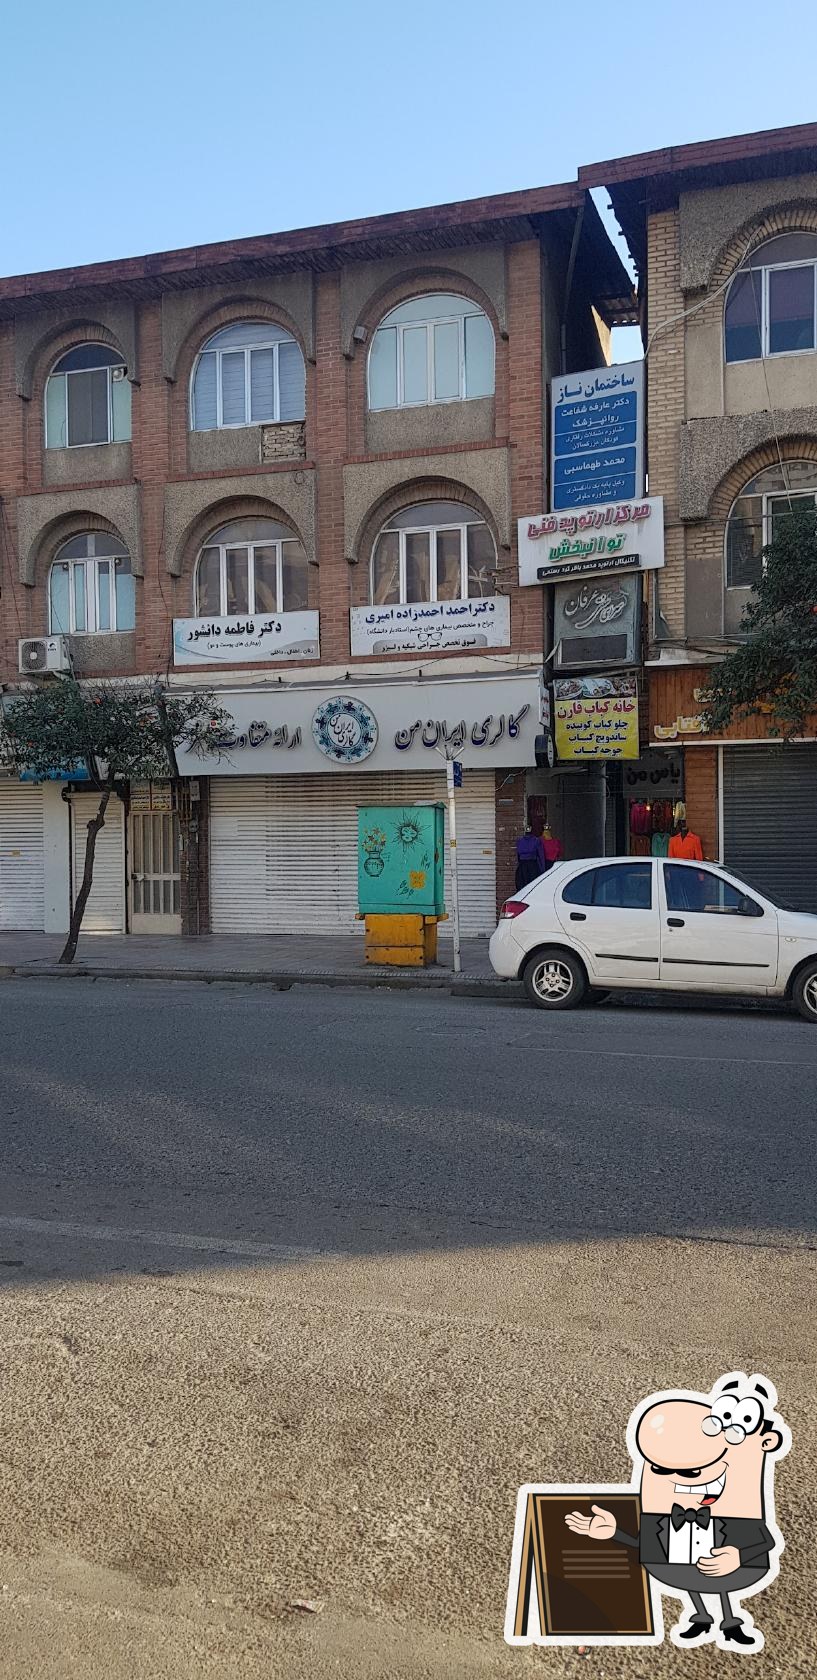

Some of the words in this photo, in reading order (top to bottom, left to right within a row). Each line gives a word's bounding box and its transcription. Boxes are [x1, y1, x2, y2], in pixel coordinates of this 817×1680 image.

[556, 381, 583, 404] ناز
[584, 373, 635, 398] ساختمان
[561, 403, 587, 417] شفاعت
[588, 400, 611, 412] عارفه
[612, 397, 630, 409] دکتر
[572, 414, 620, 428] روانپزشک
[563, 460, 601, 475] طهماسبی
[602, 457, 626, 467] محمد
[613, 503, 652, 524] مرکز
[527, 516, 558, 540] فنی
[614, 556, 636, 566] تکنیکال
[542, 568, 560, 577] رستمی
[564, 585, 600, 617] عرفان
[446, 602, 472, 616] احمد
[472, 601, 496, 617] دکتر
[365, 609, 394, 625] امیری
[187, 623, 222, 642] دانشور
[225, 620, 255, 635] فاطمه
[258, 619, 282, 638] دکتر
[417, 642, 441, 650] جراحی
[461, 638, 476, 648] فوق
[584, 700, 610, 716] کباب
[612, 699, 636, 713] خانه
[566, 720, 593, 731] کوبیده
[594, 720, 612, 730] کباب
[614, 720, 628, 730] چلو
[394, 720, 422, 752] من
[422, 720, 467, 748] ایران
[568, 732, 594, 742] کباب
[596, 733, 627, 744] ساندویچ
[574, 746, 600, 754] کباب
[600, 746, 622, 757] جوجه
